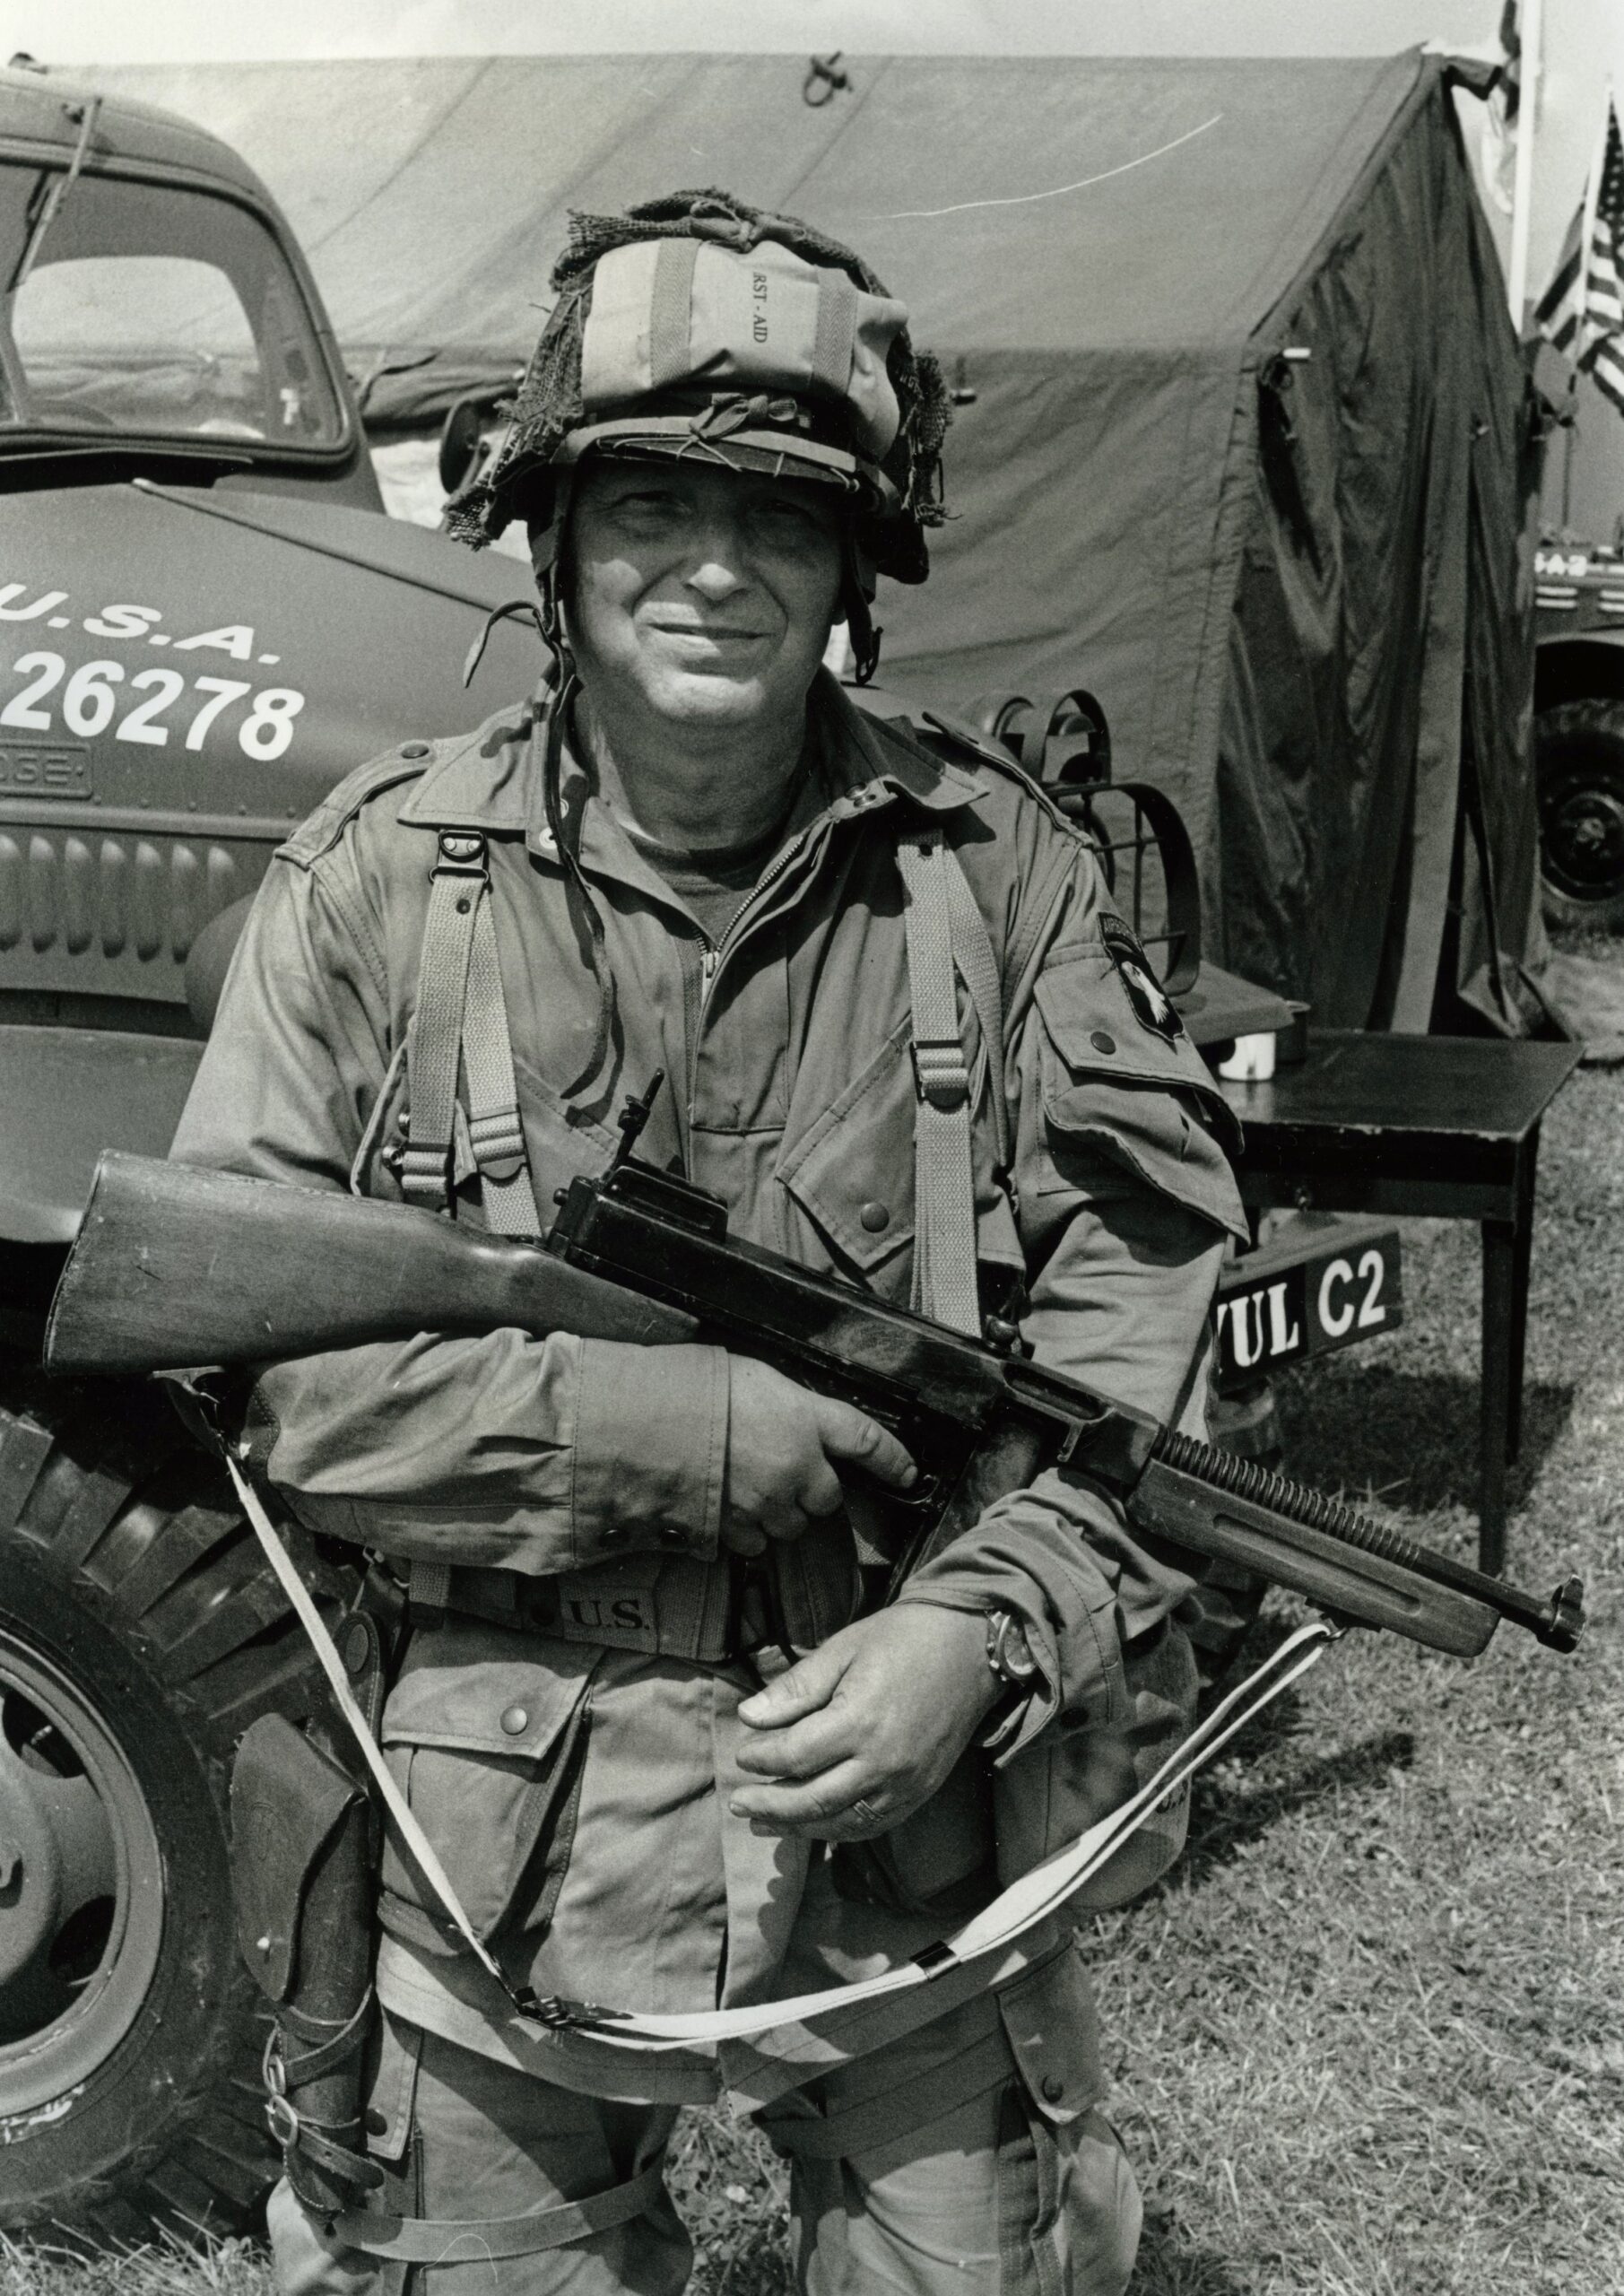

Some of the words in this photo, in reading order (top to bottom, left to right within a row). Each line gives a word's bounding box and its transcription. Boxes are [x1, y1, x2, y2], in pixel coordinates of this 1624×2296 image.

[753, 314, 768, 344] AID
[0, 583, 281, 665] U.S.A.
[0, 651, 305, 761] 26278
[1217, 1283, 1299, 1368] UL
[1318, 1250, 1386, 1337] C2
[569, 1599, 650, 1631] U.S.
